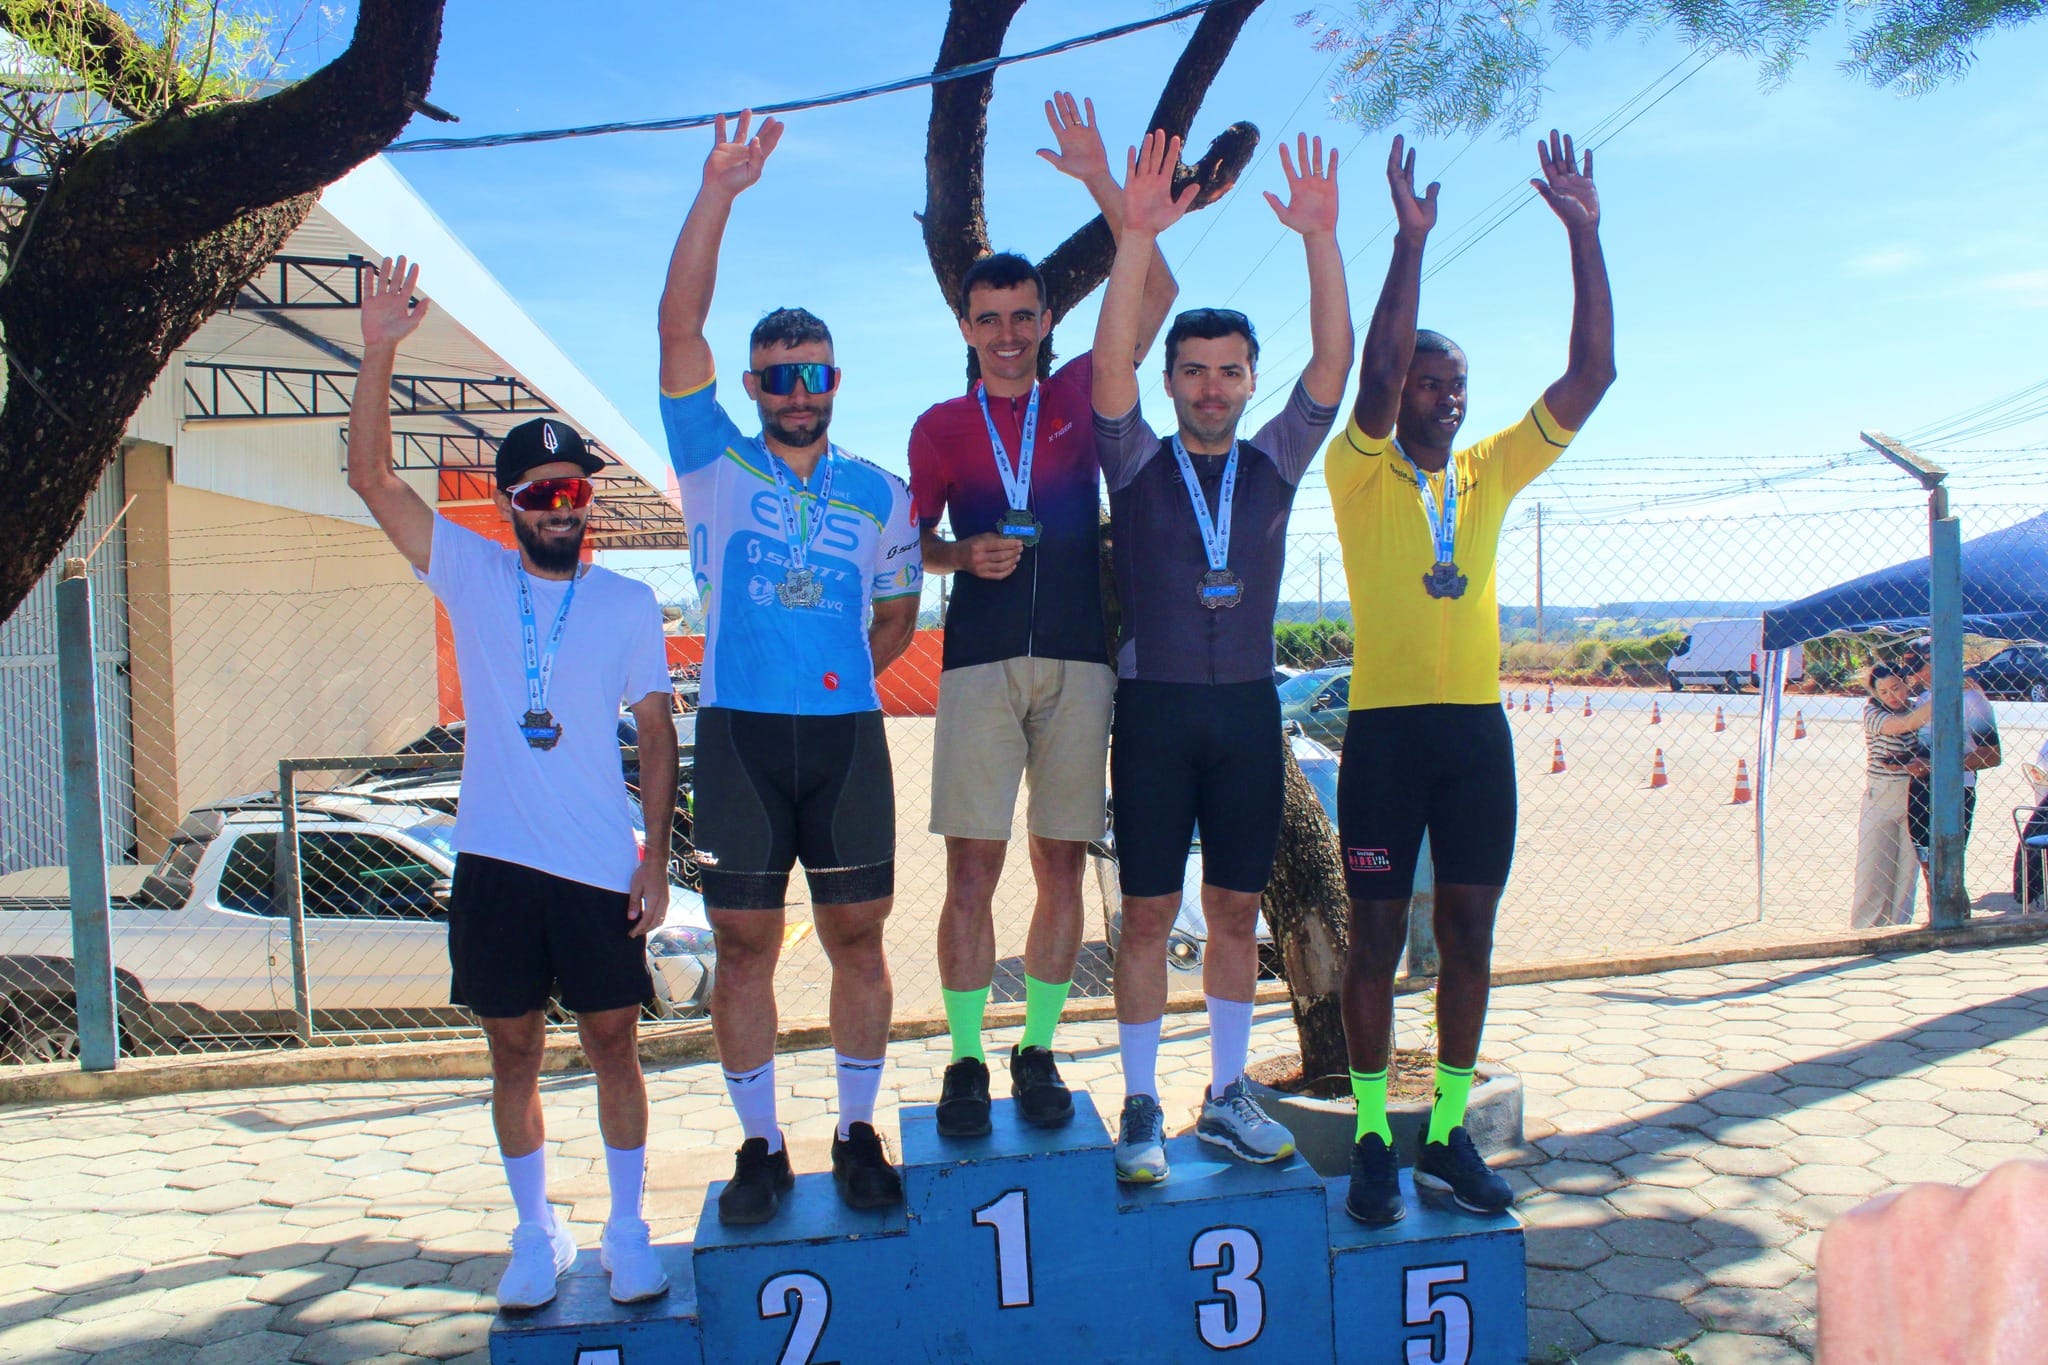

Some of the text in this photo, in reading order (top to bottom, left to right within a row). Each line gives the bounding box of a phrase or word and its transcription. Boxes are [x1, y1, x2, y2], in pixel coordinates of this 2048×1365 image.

[972, 1188, 1034, 1309] 1
[1189, 1223, 1266, 1350] 3
[757, 1269, 841, 1365] 2
[1402, 1260, 1473, 1365] 5
